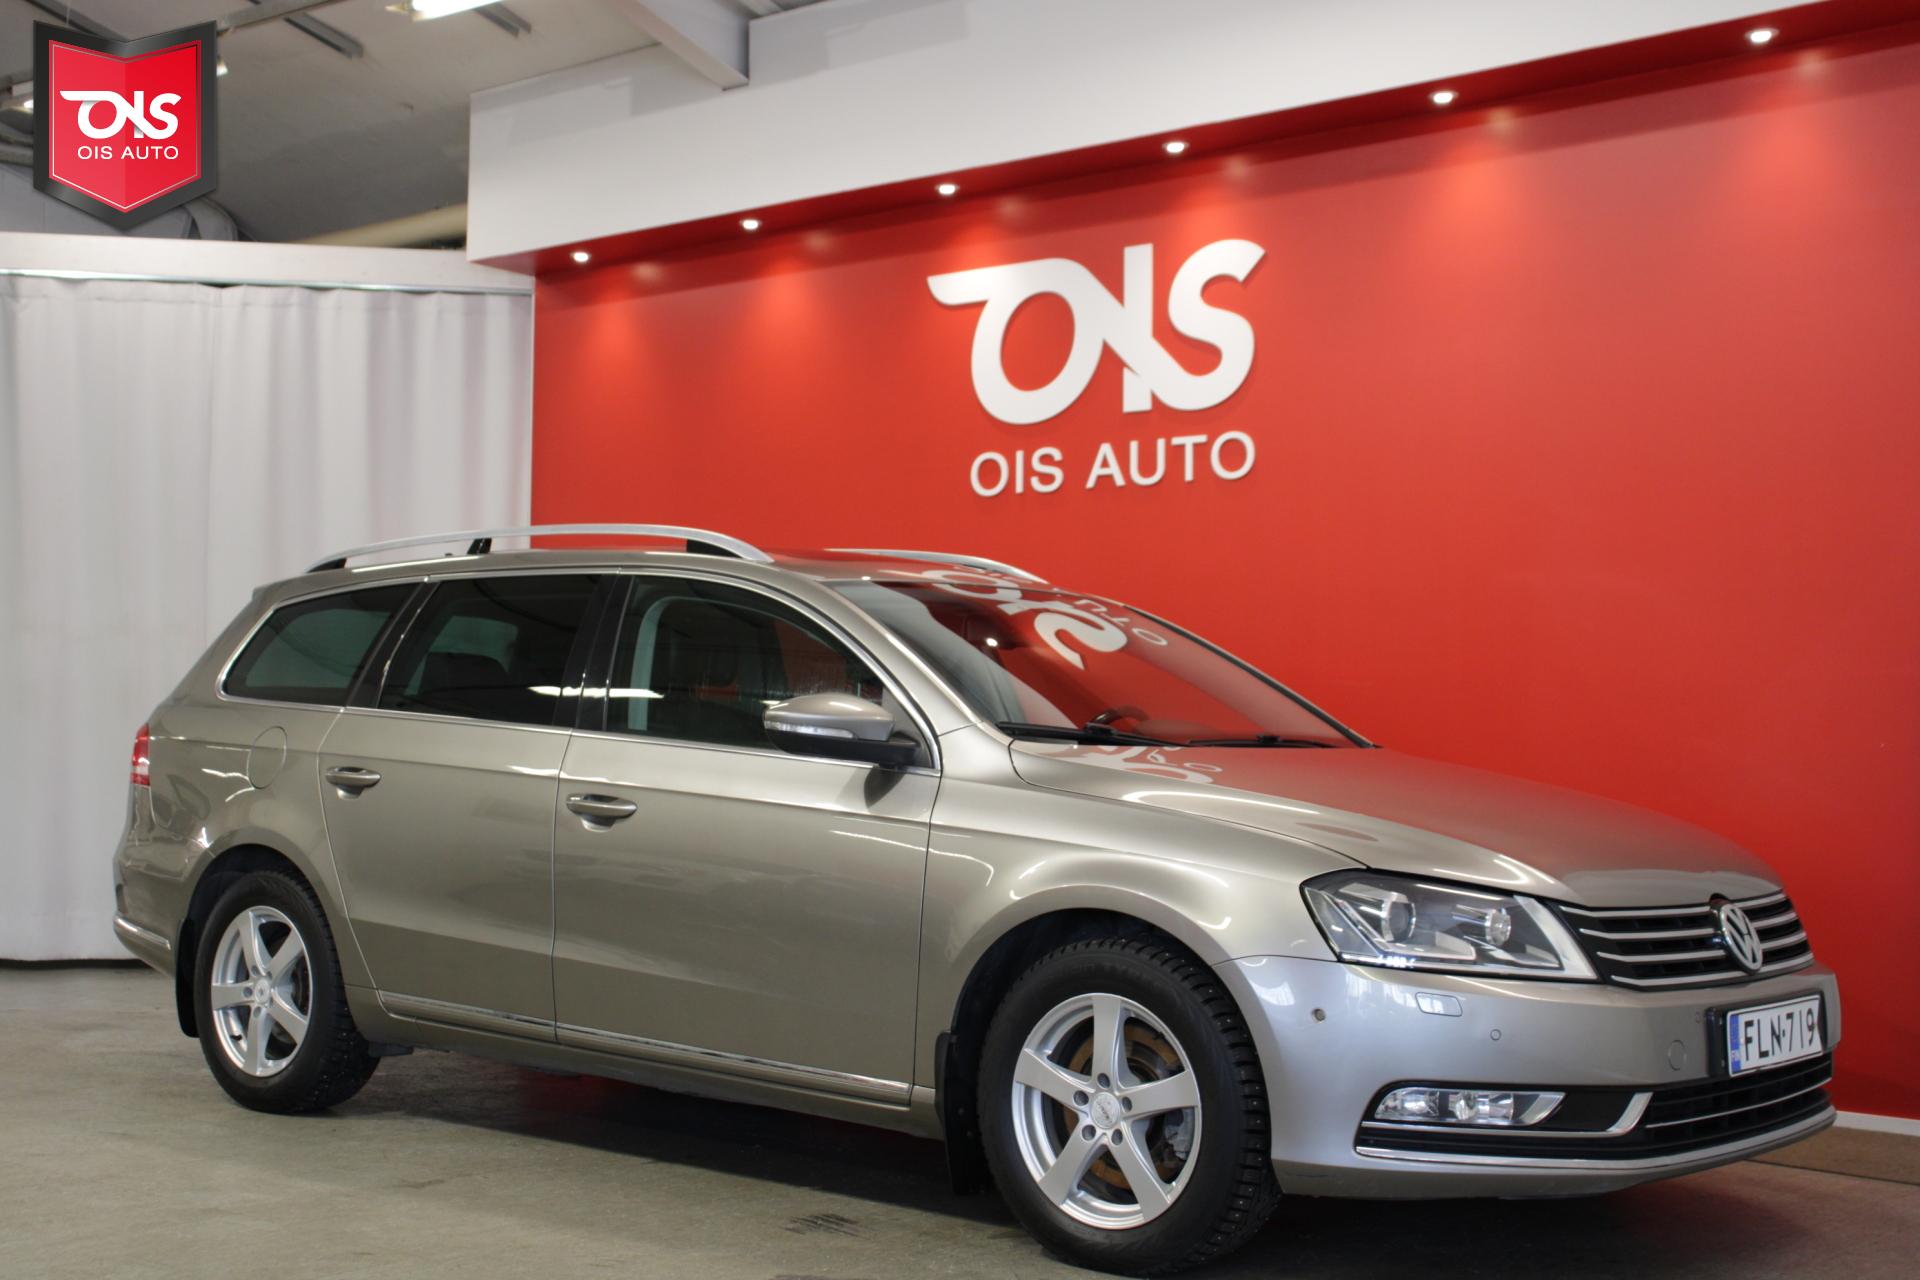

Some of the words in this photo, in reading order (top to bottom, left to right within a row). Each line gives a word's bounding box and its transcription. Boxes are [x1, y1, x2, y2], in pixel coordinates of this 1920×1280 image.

[927, 239, 1266, 425] OIS
[970, 446, 1064, 496] OIS
[1086, 431, 1256, 489] AUTO
